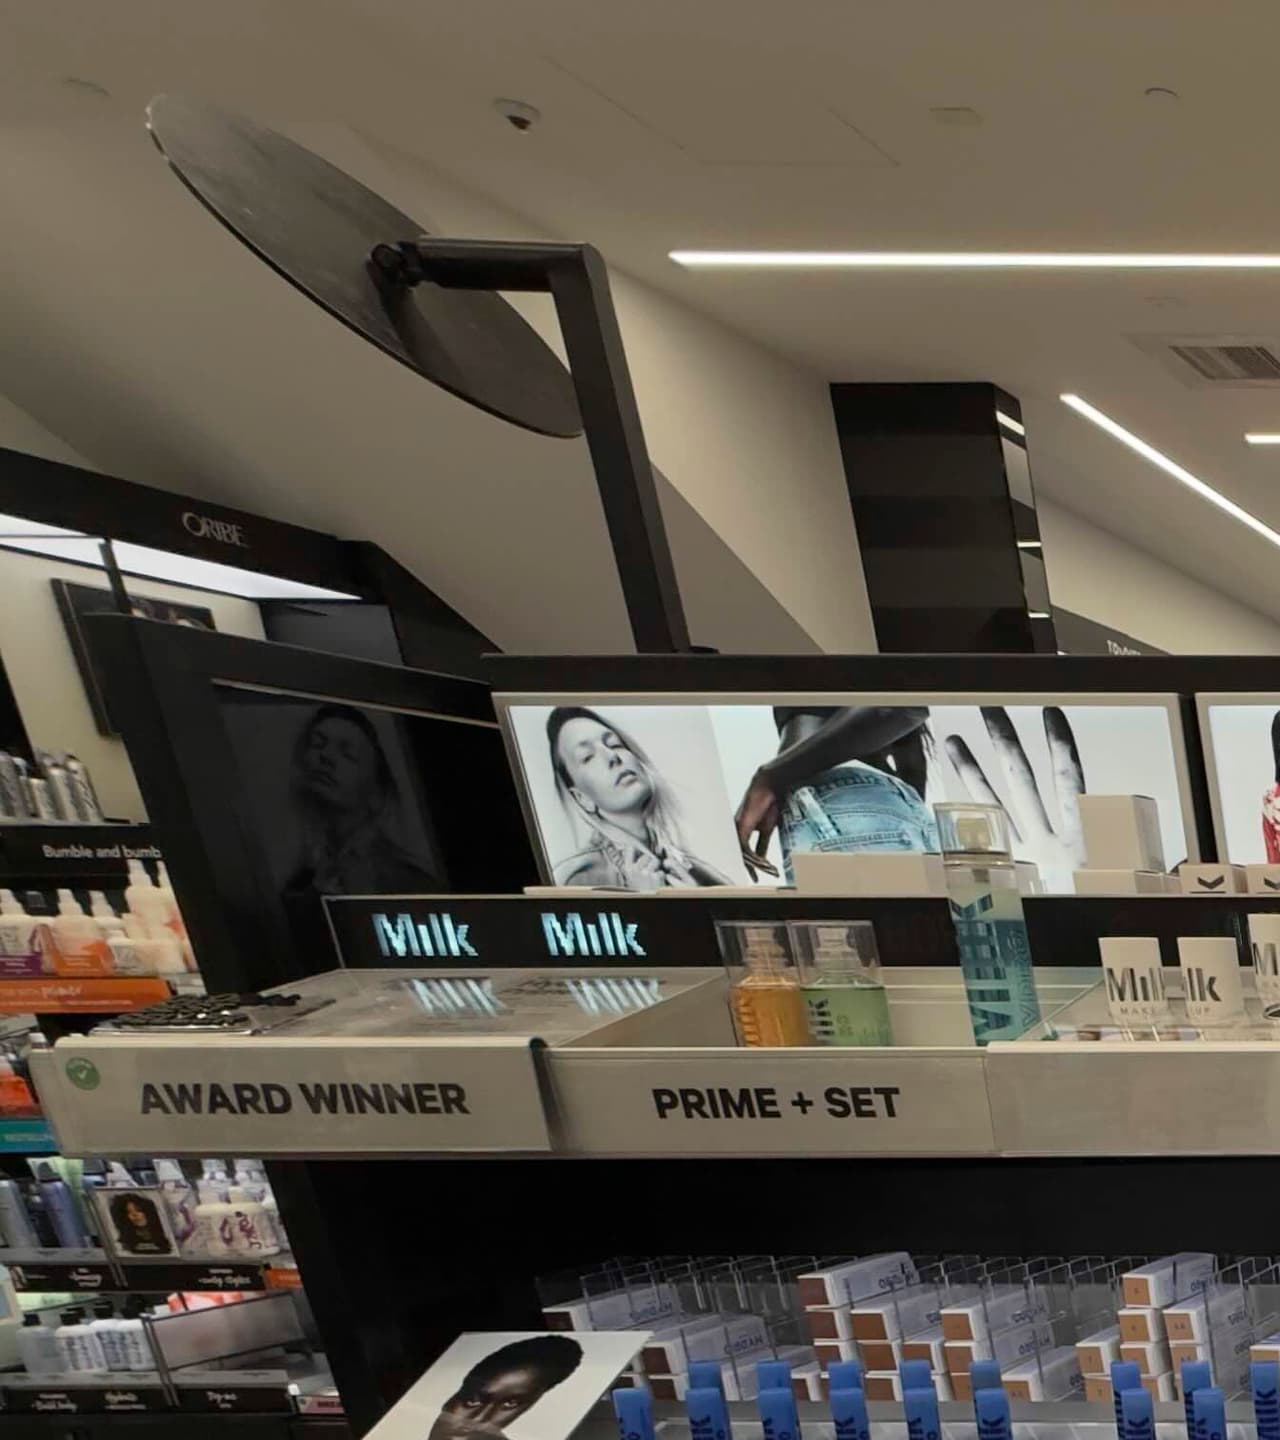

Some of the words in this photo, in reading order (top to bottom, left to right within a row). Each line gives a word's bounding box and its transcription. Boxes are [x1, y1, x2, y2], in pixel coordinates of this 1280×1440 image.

[181, 511, 245, 546] ORIBE
[42, 844, 94, 859] Bumble
[96, 844, 121, 858] and
[370, 912, 480, 957] Milk
[540, 912, 648, 957] Milk
[141, 1082, 293, 1115] AWARD
[300, 1082, 471, 1115] WINNER
[652, 1087, 782, 1119] PRIME
[791, 1091, 814, 1115] +
[823, 1087, 900, 1119] SET
